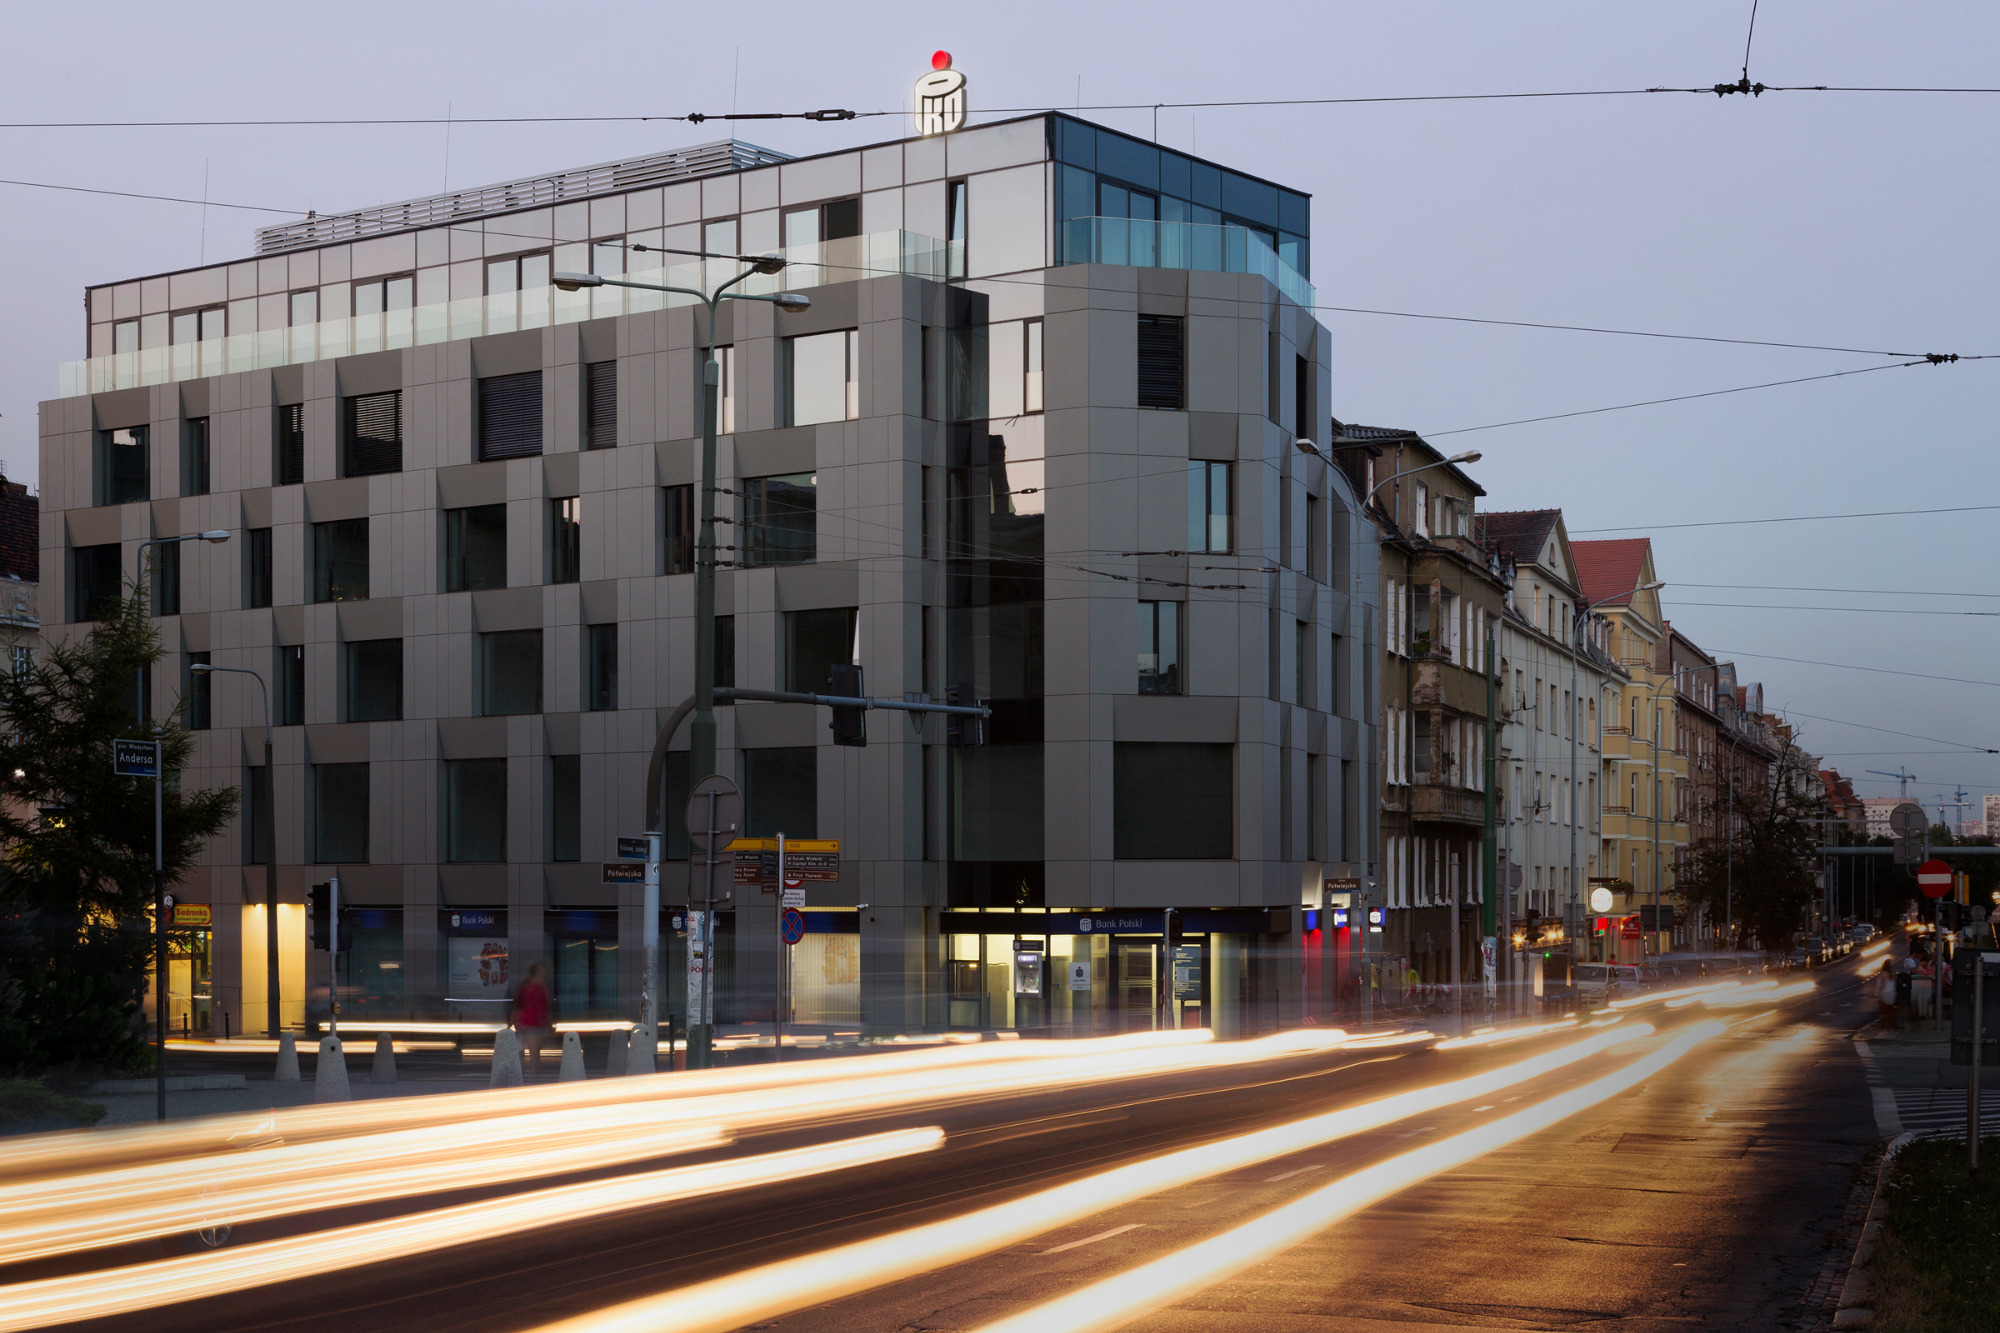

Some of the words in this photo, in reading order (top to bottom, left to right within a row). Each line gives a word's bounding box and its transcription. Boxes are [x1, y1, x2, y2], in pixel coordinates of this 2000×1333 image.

[119, 751, 153, 764] Andersa
[607, 869, 642, 878] Półwiejska
[176, 908, 208, 916] Biedronka
[462, 916, 477, 924] Bank
[478, 916, 495, 924] Polski
[1096, 919, 1116, 928] Bank
[1119, 918, 1143, 928] Polski
